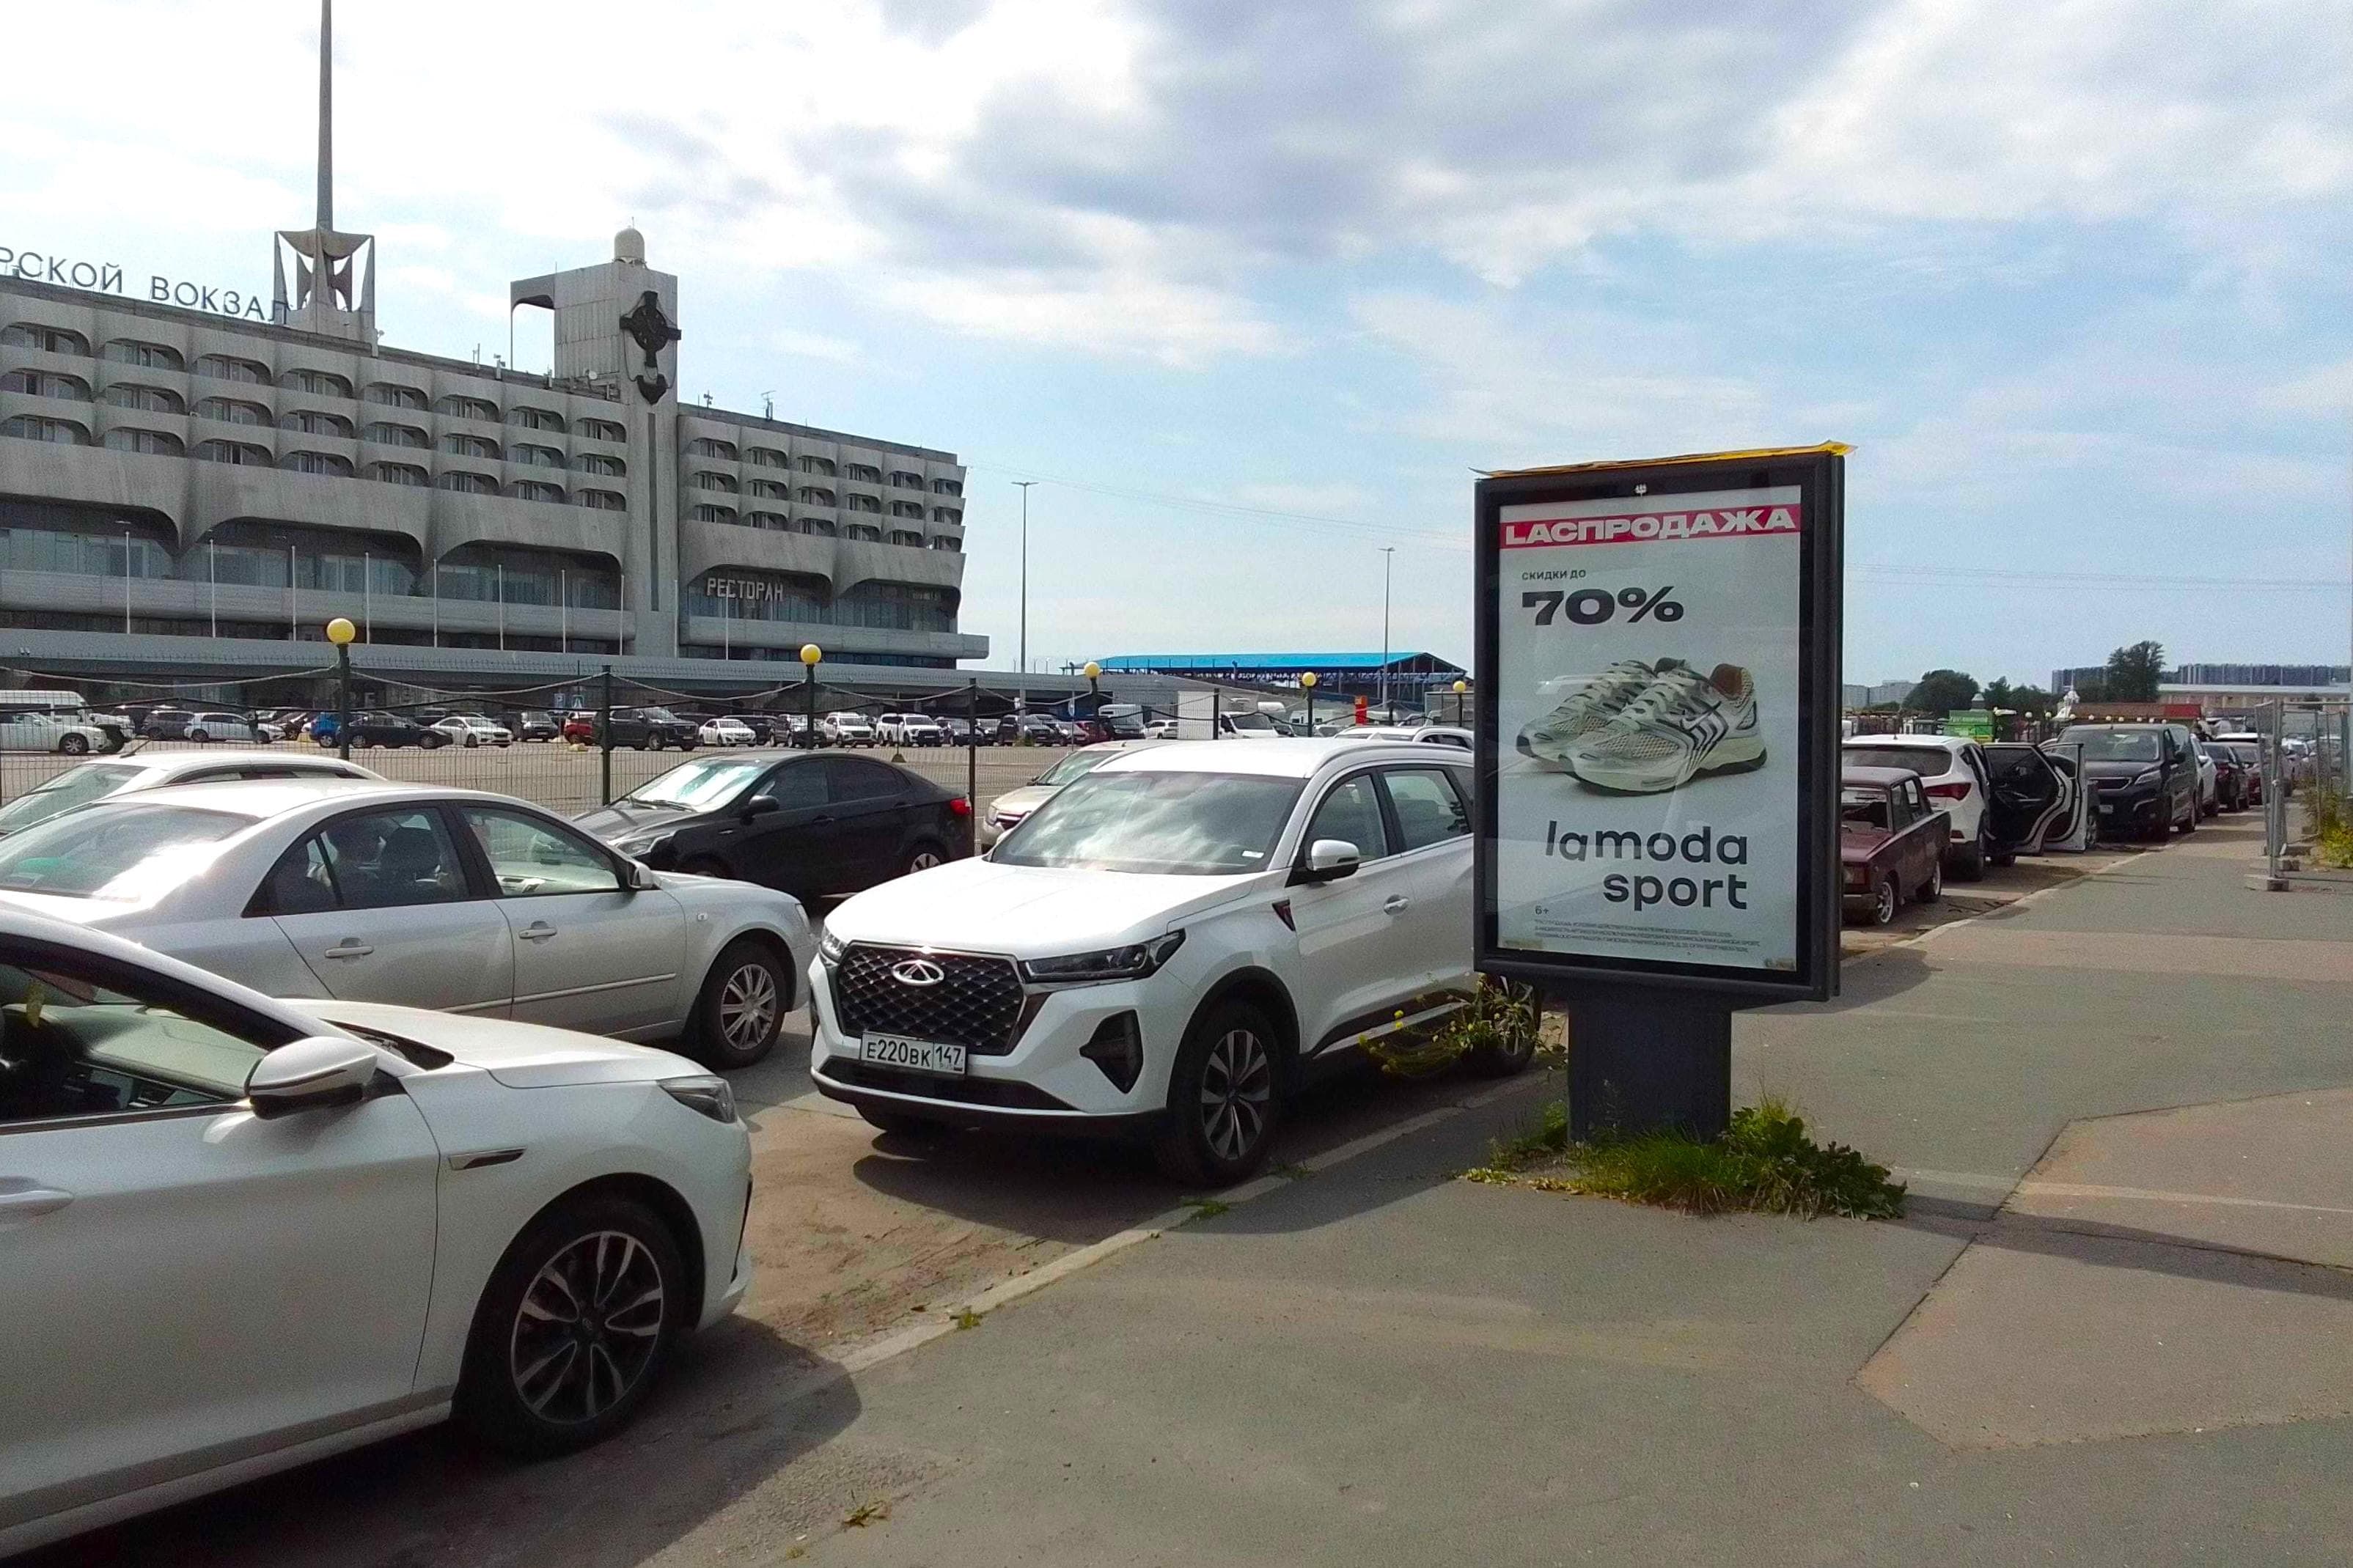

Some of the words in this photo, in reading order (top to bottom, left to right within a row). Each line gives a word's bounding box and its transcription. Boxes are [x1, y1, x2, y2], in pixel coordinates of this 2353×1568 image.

[151, 276, 287, 325] ВОКЗАЛ
[706, 577, 783, 601] РЕСТОРАН
[1521, 570, 1567, 581] СКИДКИ
[1570, 570, 1587, 580] ДО
[1521, 586, 1684, 626] 70%
[1545, 820, 1748, 865] lamoda
[1603, 873, 1747, 911] sport
